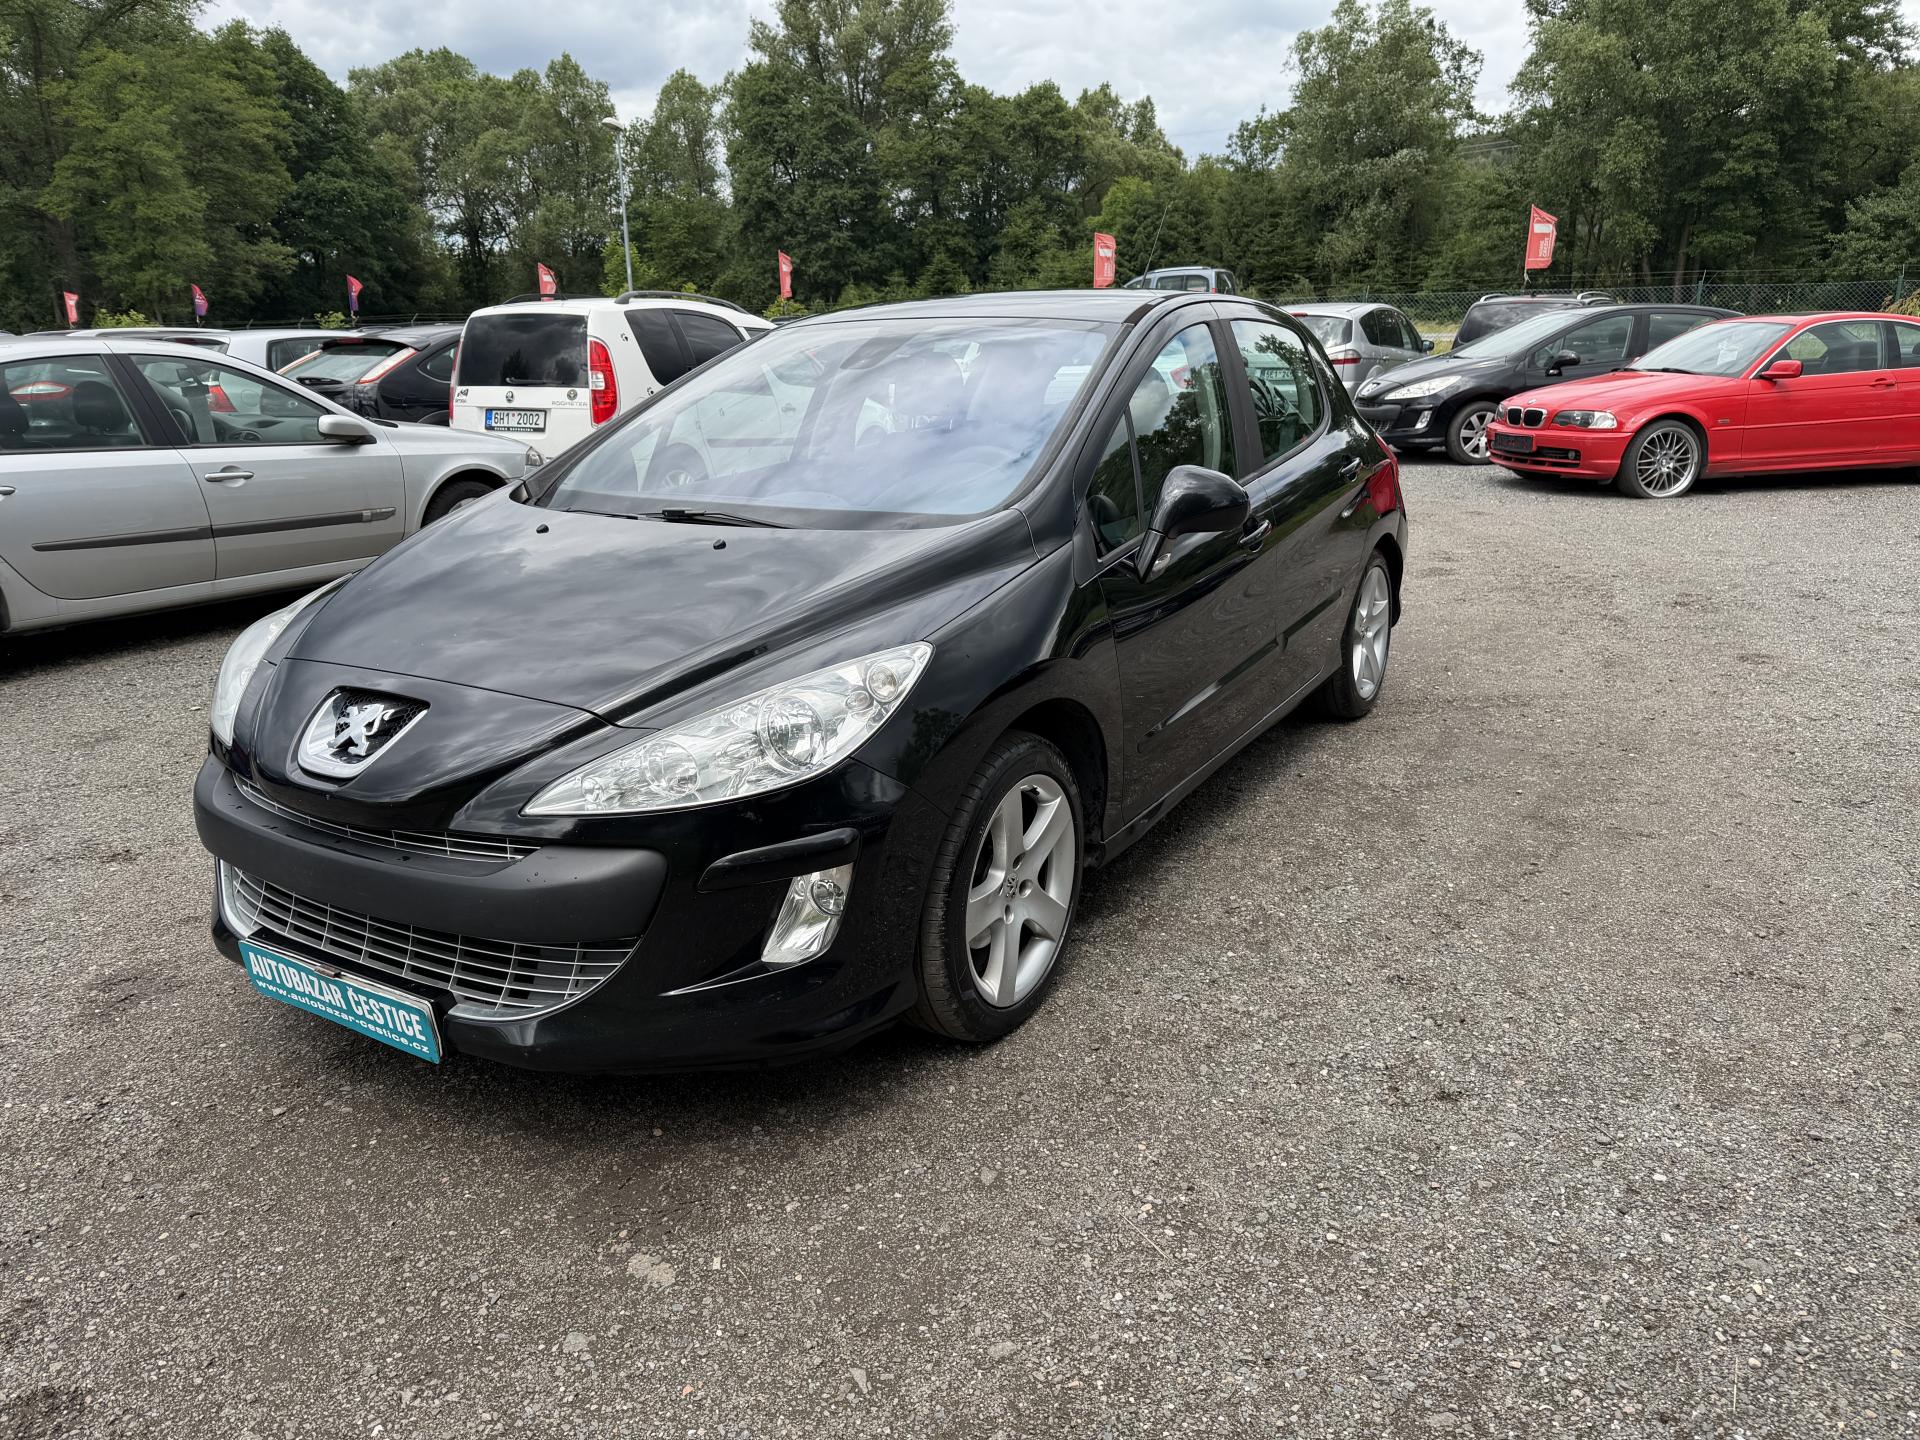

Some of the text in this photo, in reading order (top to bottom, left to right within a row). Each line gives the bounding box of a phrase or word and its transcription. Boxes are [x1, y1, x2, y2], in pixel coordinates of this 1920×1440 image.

[493, 412, 540, 426] 6H1 2002
[248, 951, 427, 1042] AUTOBAZAR ČESTICE
[255, 978, 430, 1054] www.autobazar-cestice.cz
